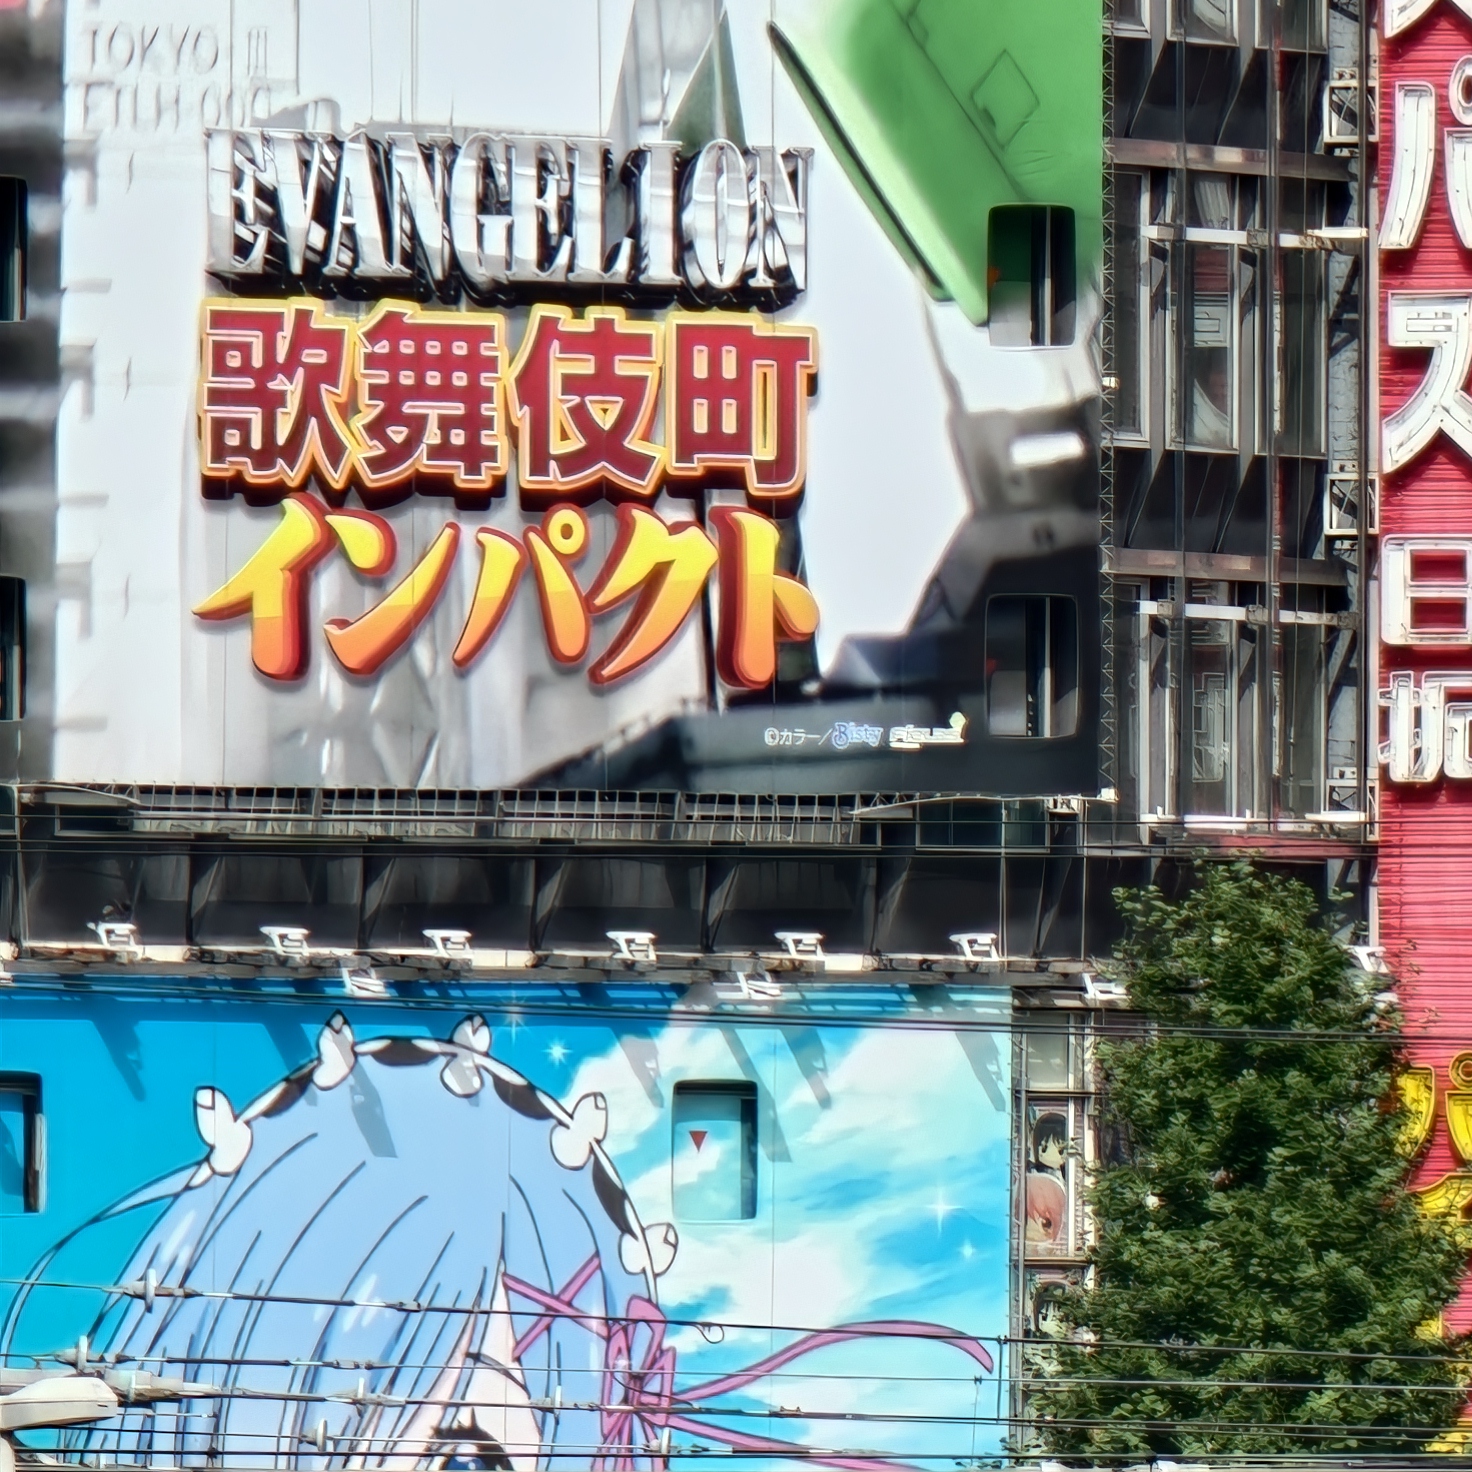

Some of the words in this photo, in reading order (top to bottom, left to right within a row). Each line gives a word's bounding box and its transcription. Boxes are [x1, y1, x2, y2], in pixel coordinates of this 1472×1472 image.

[205, 128, 813, 300] EVANGELION
[199, 297, 819, 496] 歌舞伎町
[193, 496, 821, 691] インパクト
